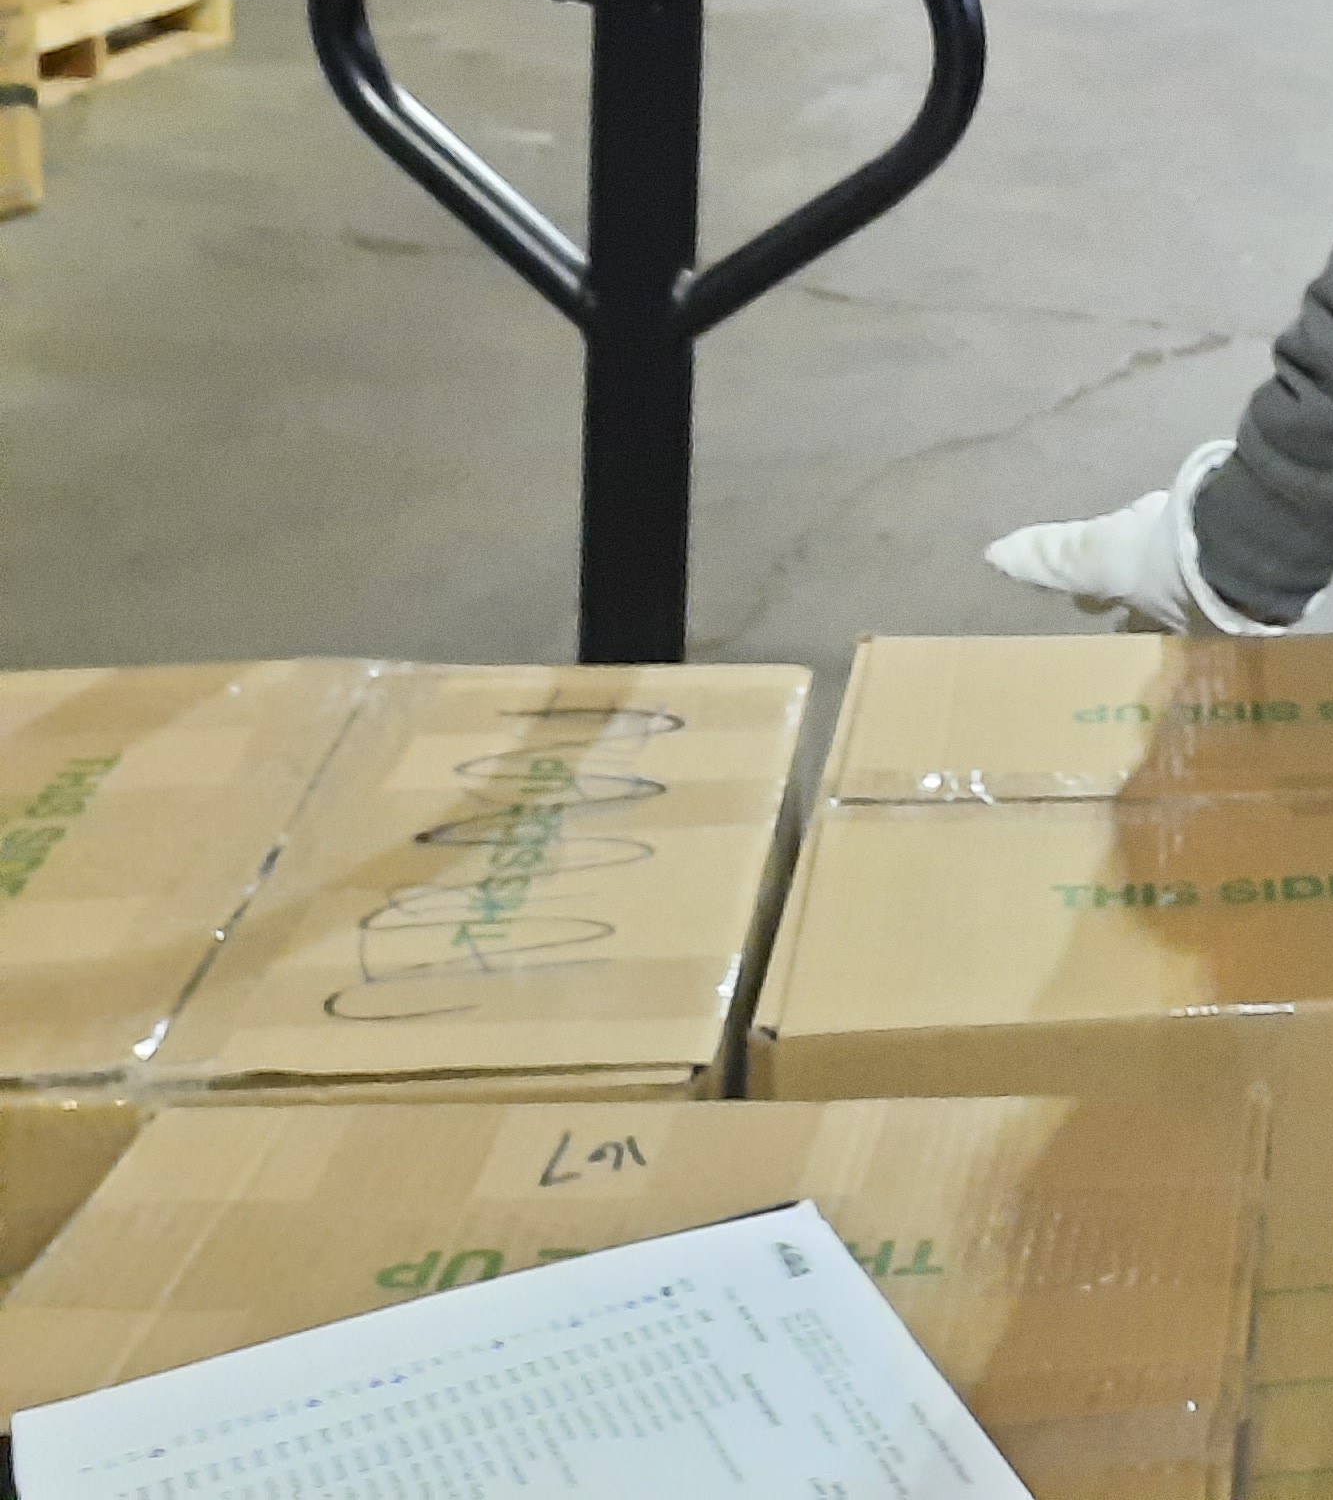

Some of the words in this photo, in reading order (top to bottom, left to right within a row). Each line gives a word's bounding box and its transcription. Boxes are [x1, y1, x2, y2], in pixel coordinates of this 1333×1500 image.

[1073, 702, 1151, 725] UP
[1175, 700, 1300, 724] SIDE
[1051, 880, 1200, 909] THIS
[375, 1248, 505, 1291] UP
[846, 1239, 944, 1277] TH
